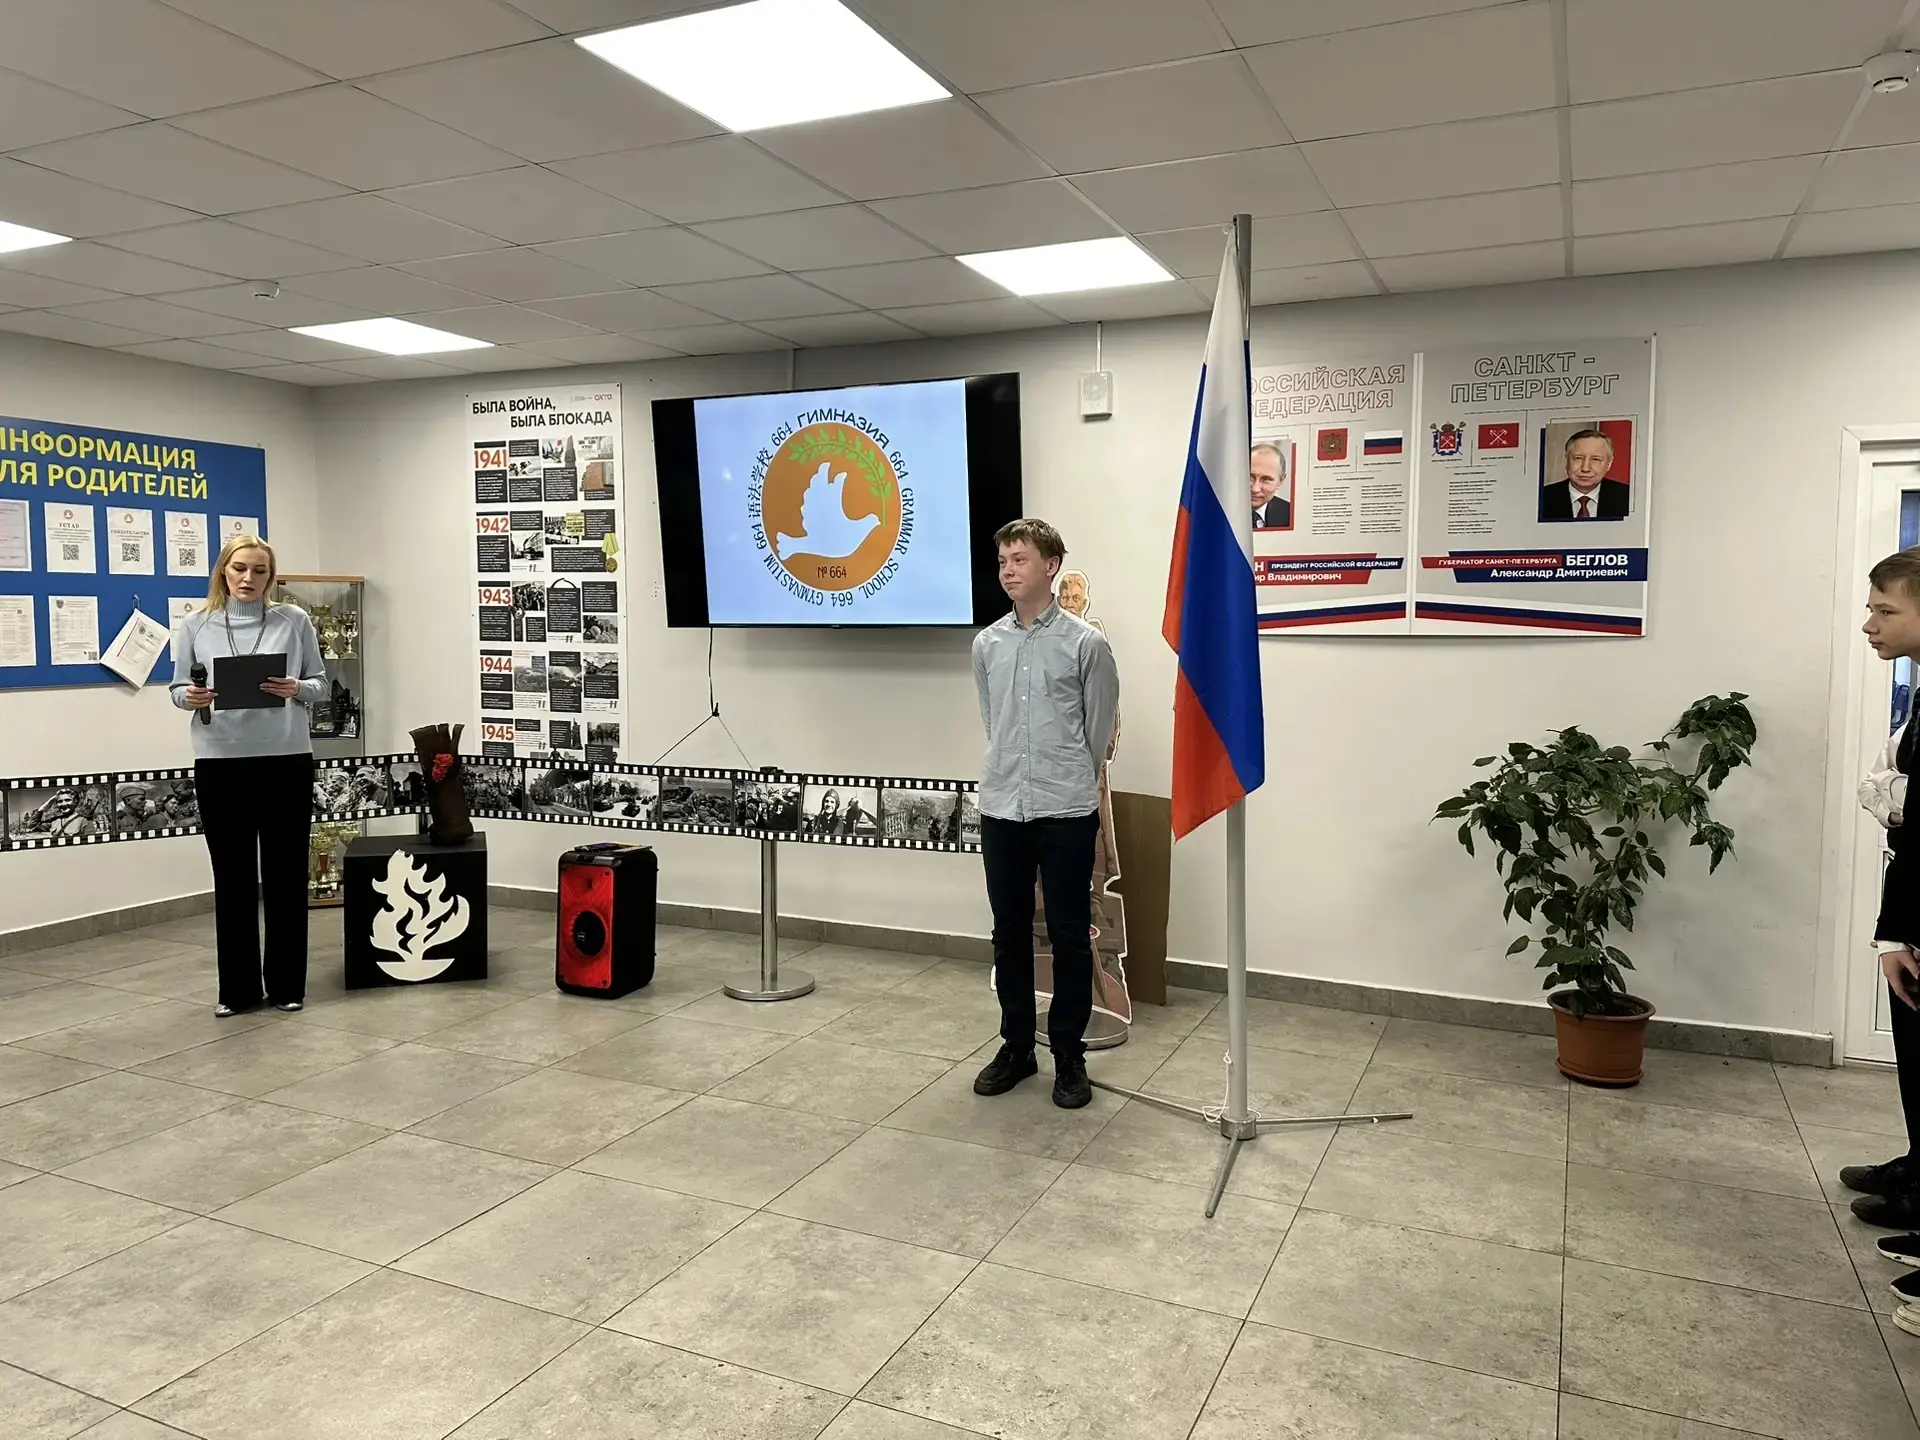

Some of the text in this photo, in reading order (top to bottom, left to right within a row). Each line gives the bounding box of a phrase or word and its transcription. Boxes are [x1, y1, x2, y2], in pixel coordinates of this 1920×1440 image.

[1474, 351, 1576, 378] САНКТ
[1250, 364, 1406, 395] ССИЙСКАЯ
[1450, 373, 1620, 404] ПЕТЕРБУРГ
[472, 400, 507, 415] БЫЛА
[509, 395, 556, 412] ВОЙНА,
[1251, 388, 1394, 420] ЕДЕРАЦИЯ
[510, 411, 613, 428] БЫЛА БЛОКАДА
[771, 408, 890, 450] 664 ГИМНАЗИЯ
[474, 449, 508, 469] 1941
[48, 463, 208, 500] РОДИТЕЛЕЙ
[476, 517, 509, 534] 1942
[859, 450, 915, 600] 664 GRAMMAR SCHOOL
[751, 522, 767, 550] 664
[1271, 562, 1309, 570] ПРЕЗИДЕНТ
[1310, 560, 1356, 569] РОССИЙСКОЙ
[1357, 560, 1399, 568] ФЕДЕРАЦИИ
[1438, 556, 1558, 567] ГУБЕРНАТОР САНКТ-ПЕТЕРБУРГА
[1565, 554, 1629, 566] БЕГЛОВ
[763, 553, 854, 608] 664 GYMNASIUM
[829, 565, 847, 579] 664
[1267, 572, 1342, 582] Владимирович
[1490, 568, 1629, 579] Александр Дмитриевич
[478, 588, 511, 605] 1943
[480, 657, 513, 673] 1944
[481, 724, 515, 741] 1945
